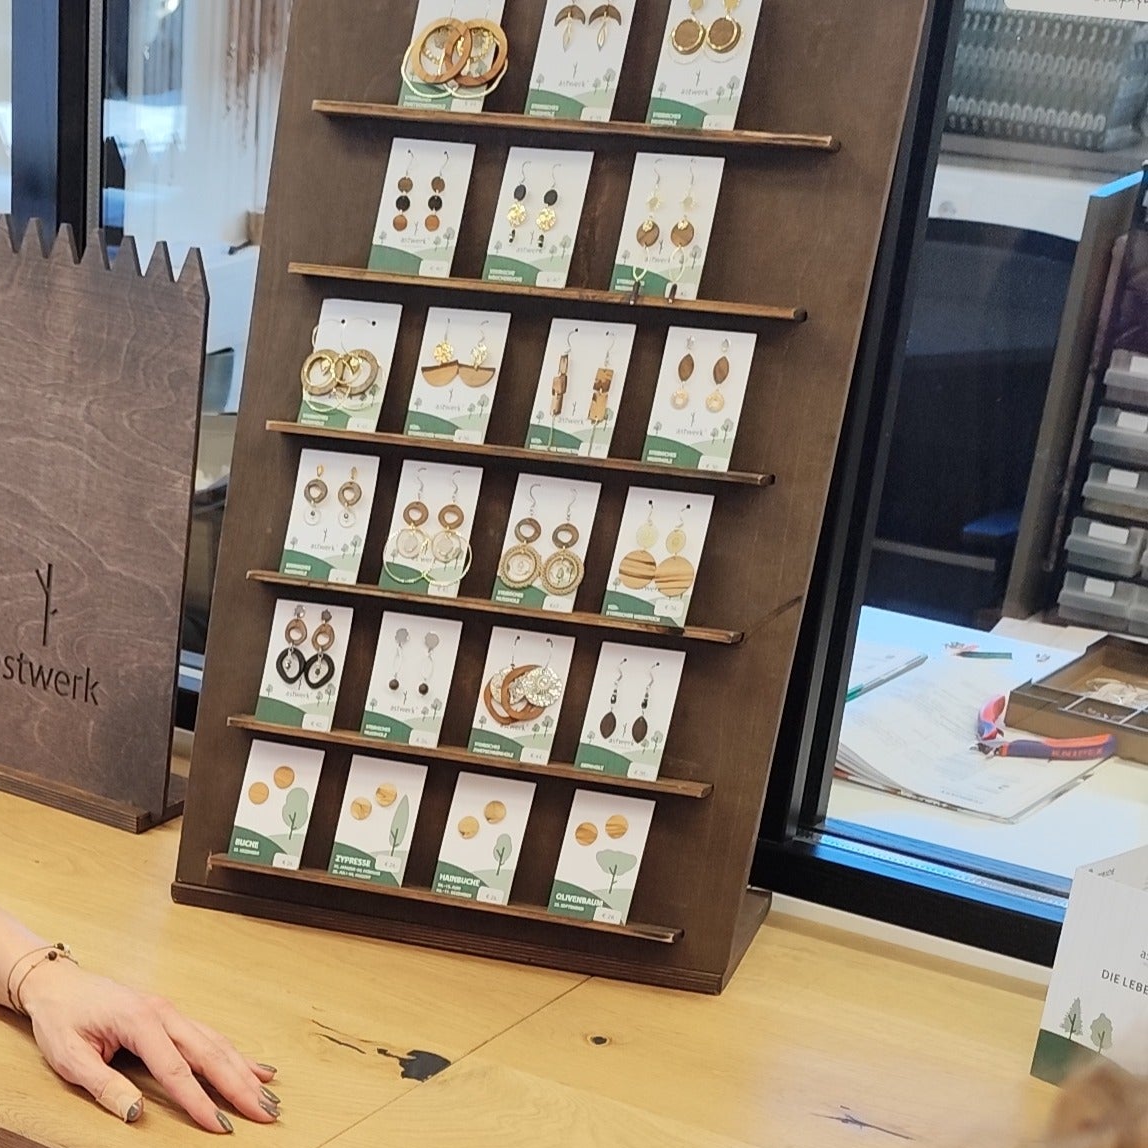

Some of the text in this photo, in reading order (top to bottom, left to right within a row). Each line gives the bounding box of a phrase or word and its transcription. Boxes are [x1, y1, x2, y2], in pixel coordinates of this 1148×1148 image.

[335, 854, 371, 867] ZYPRESSE
[439, 873, 481, 887] HAINBUCHE
[556, 892, 603, 907] OLIVENBAUM
[1102, 969, 1120, 984] DIE
